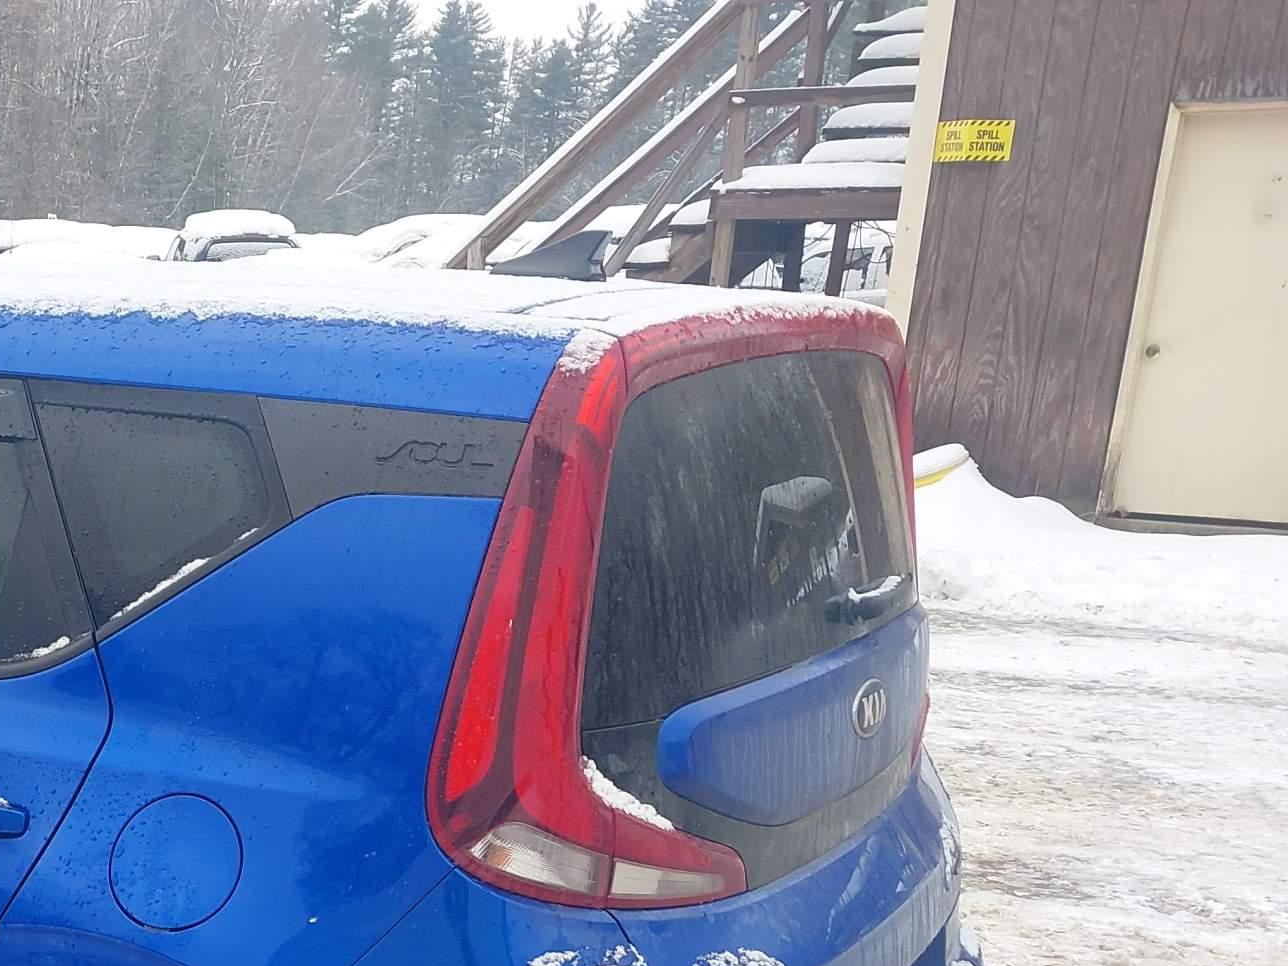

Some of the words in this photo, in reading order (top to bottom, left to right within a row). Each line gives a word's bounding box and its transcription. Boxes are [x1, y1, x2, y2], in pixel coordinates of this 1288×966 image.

[946, 130, 961, 140] SPILL
[976, 129, 1000, 139] SPILL
[940, 142, 963, 152] STATION
[968, 141, 1004, 151] STATION
